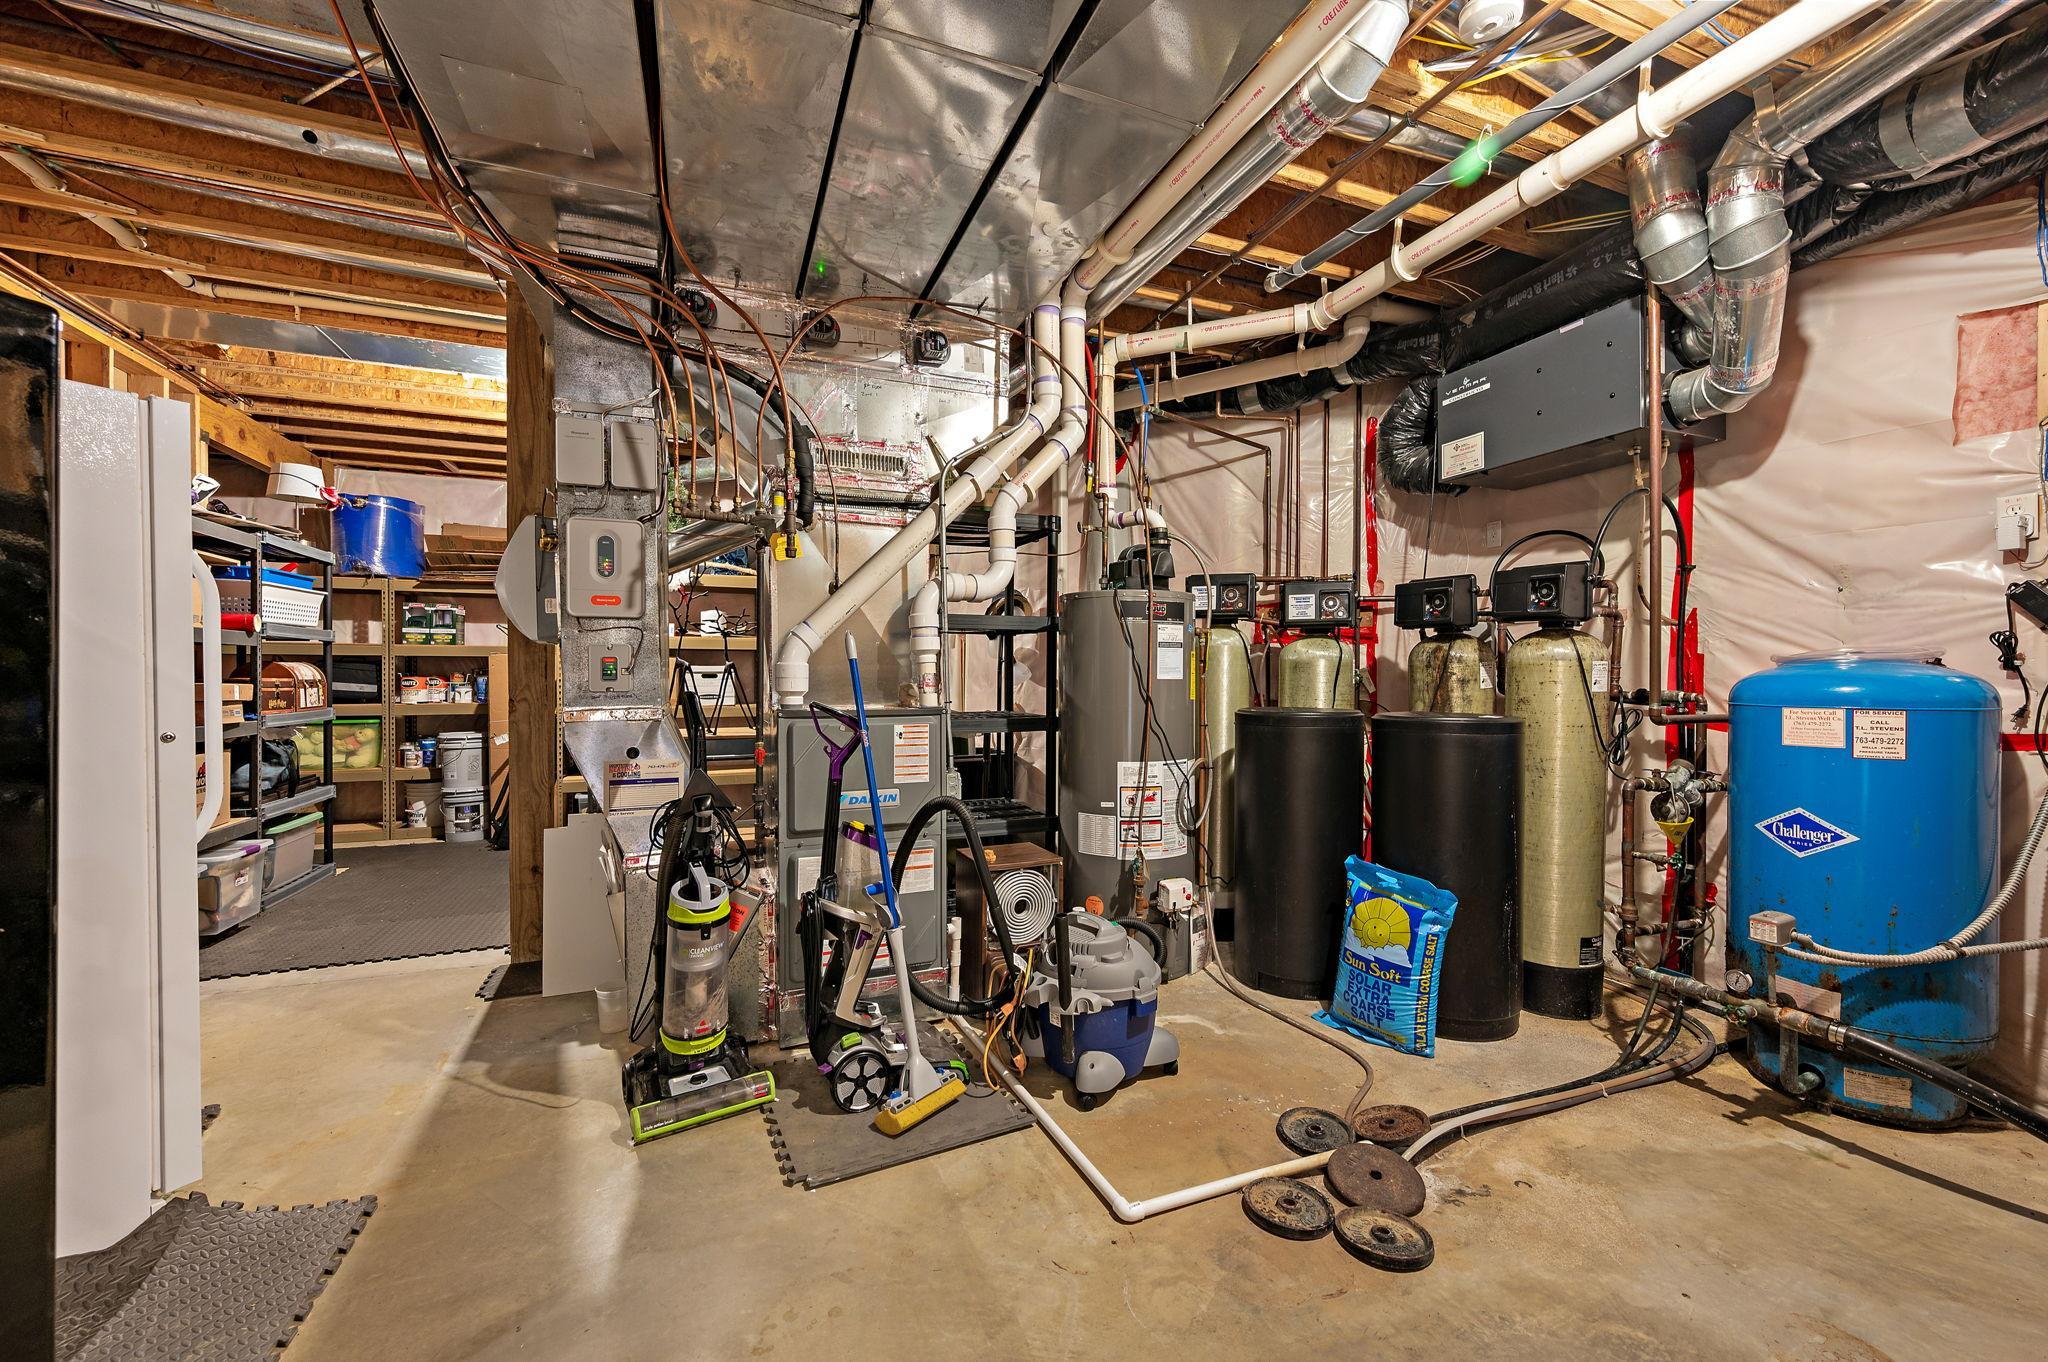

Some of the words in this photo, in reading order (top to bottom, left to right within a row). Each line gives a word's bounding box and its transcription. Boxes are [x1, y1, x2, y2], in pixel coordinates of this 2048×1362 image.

[1854, 736, 1905, 746] 763-479-2272
[848, 794, 898, 805] DAKIN
[1772, 821, 1835, 844] Challenger
[1426, 934, 1439, 957] SALT
[1344, 950, 1366, 972] Sun
[1368, 962, 1402, 984] Soft
[1349, 968, 1392, 996] SOLAR
[1343, 990, 1396, 1021] COARSE
[1347, 981, 1391, 1008] EXTRA
[1351, 1006, 1384, 1028] SALT
